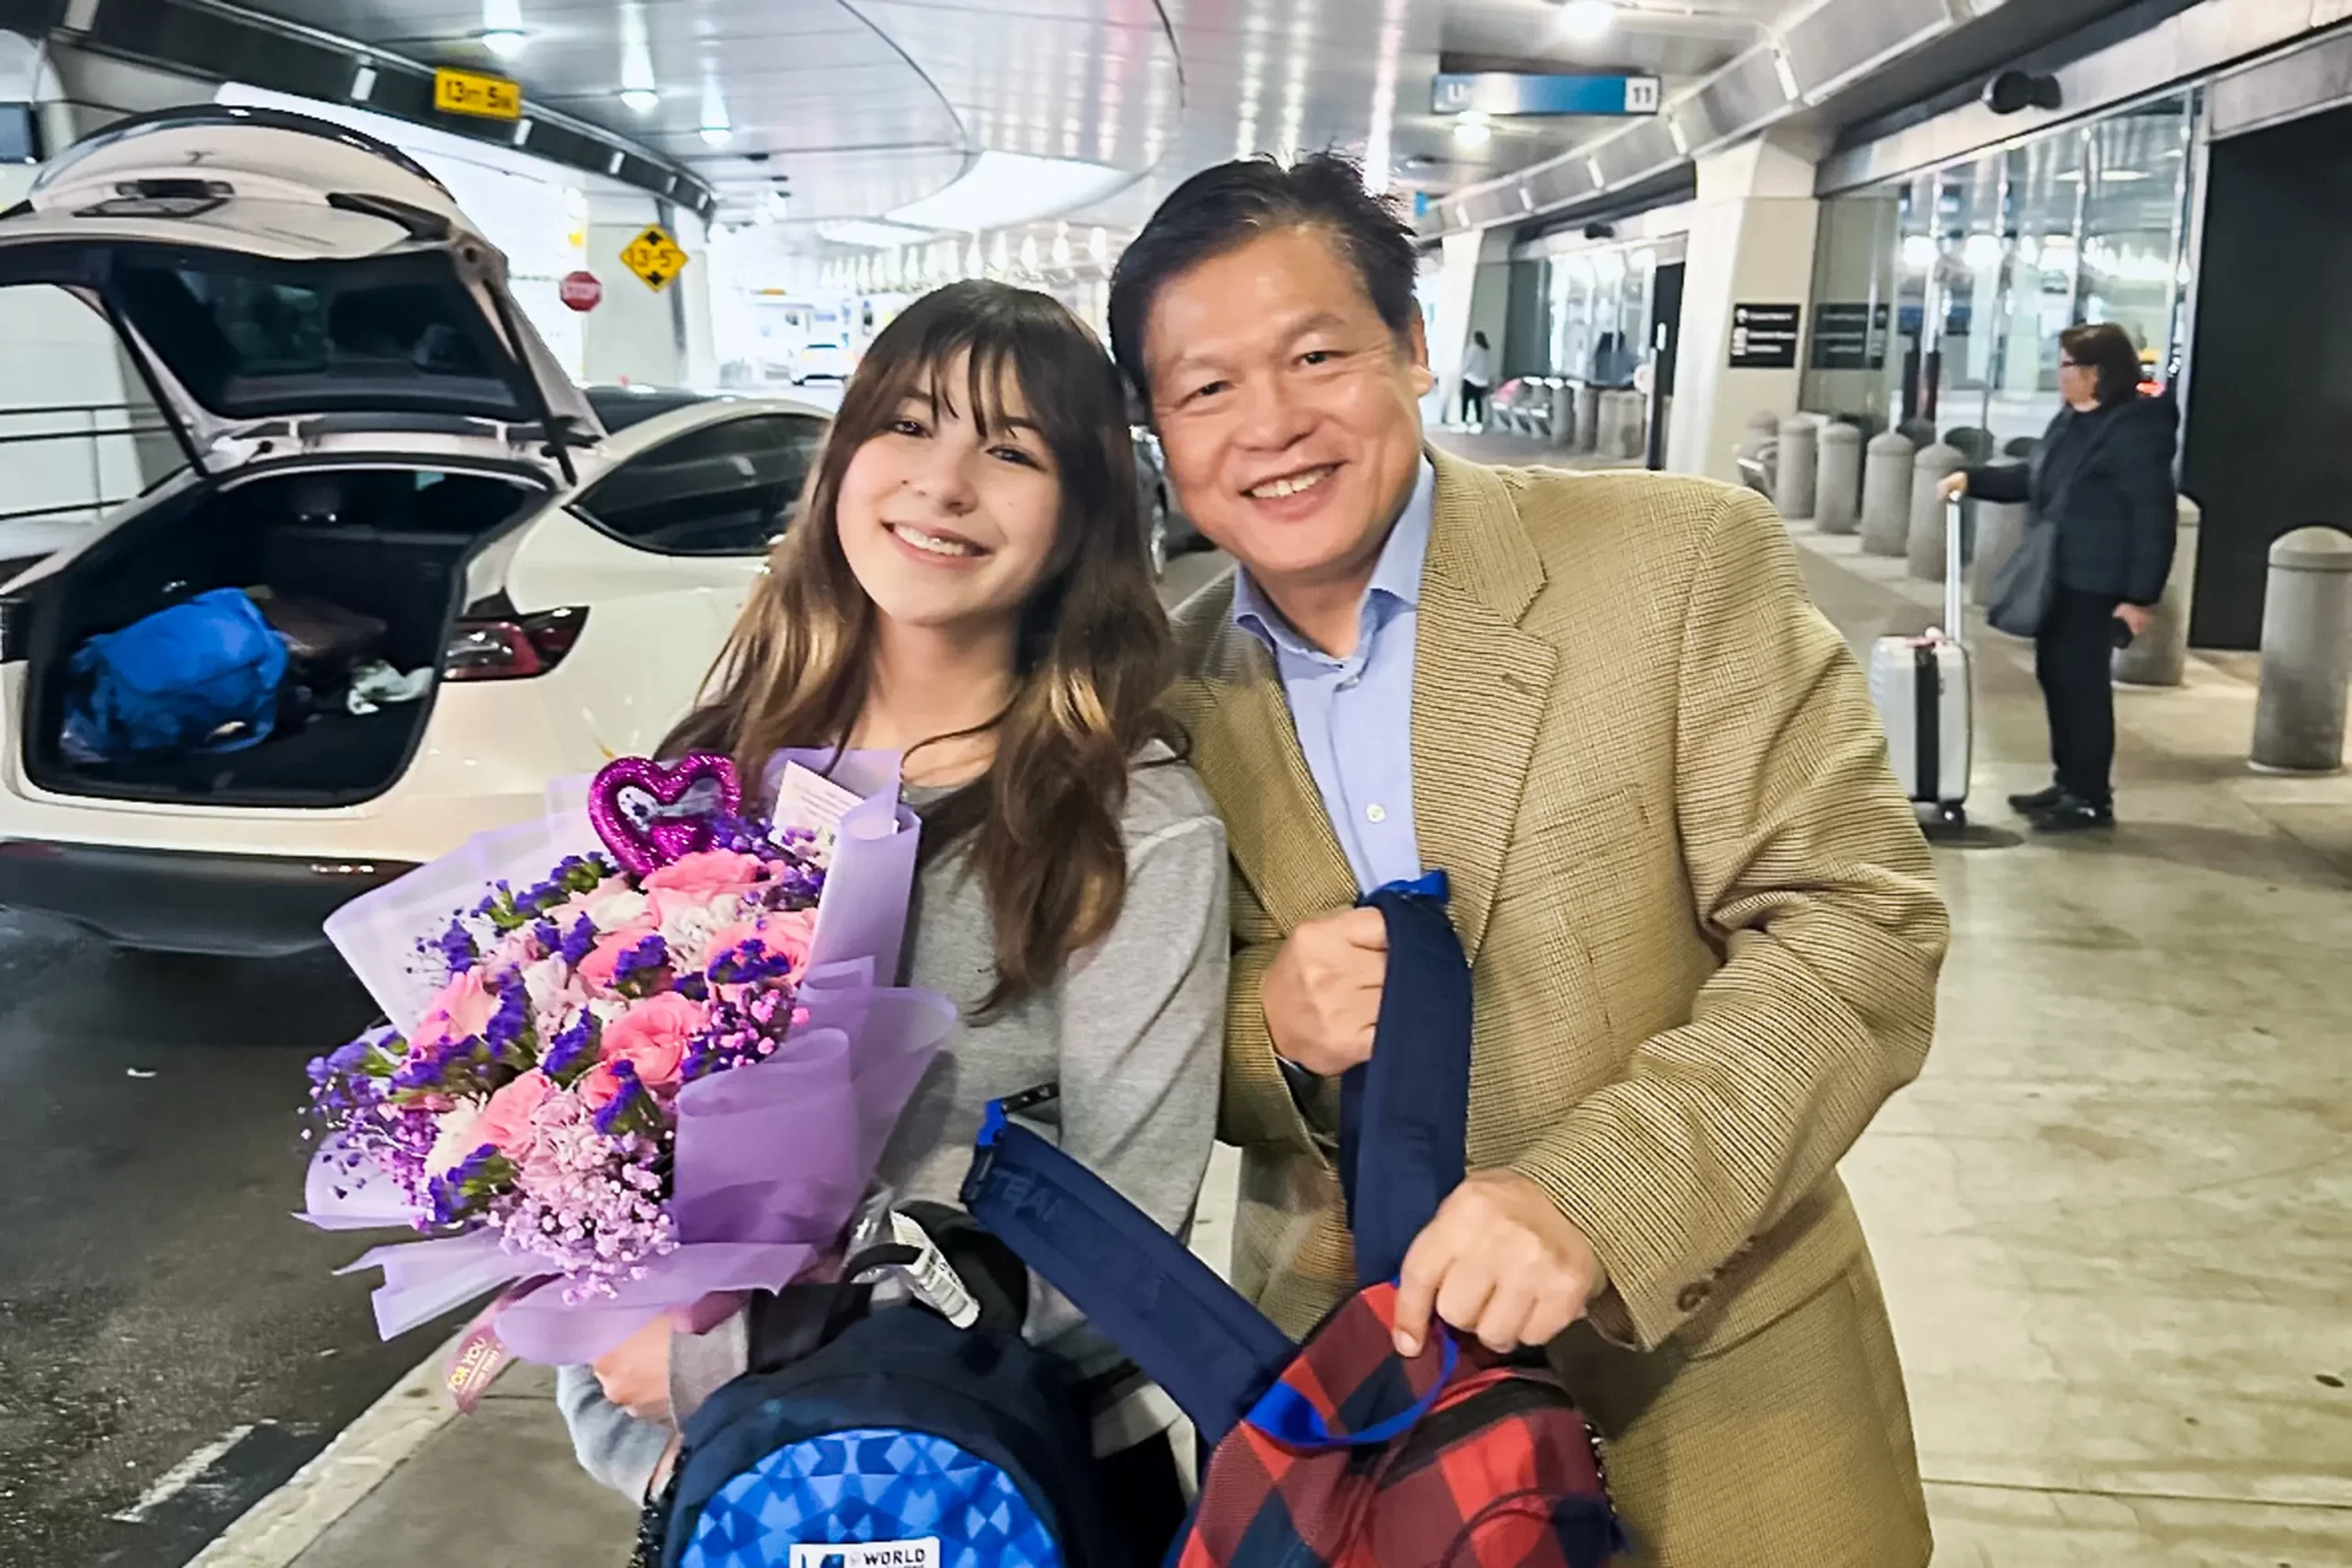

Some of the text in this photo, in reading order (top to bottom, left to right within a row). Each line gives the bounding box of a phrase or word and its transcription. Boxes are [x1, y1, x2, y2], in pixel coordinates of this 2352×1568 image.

[1634, 86, 1652, 104] 11
[447, 1366, 471, 1393] FOR
[461, 1336, 486, 1366] YOU
[864, 1548, 926, 1565] WORLD
